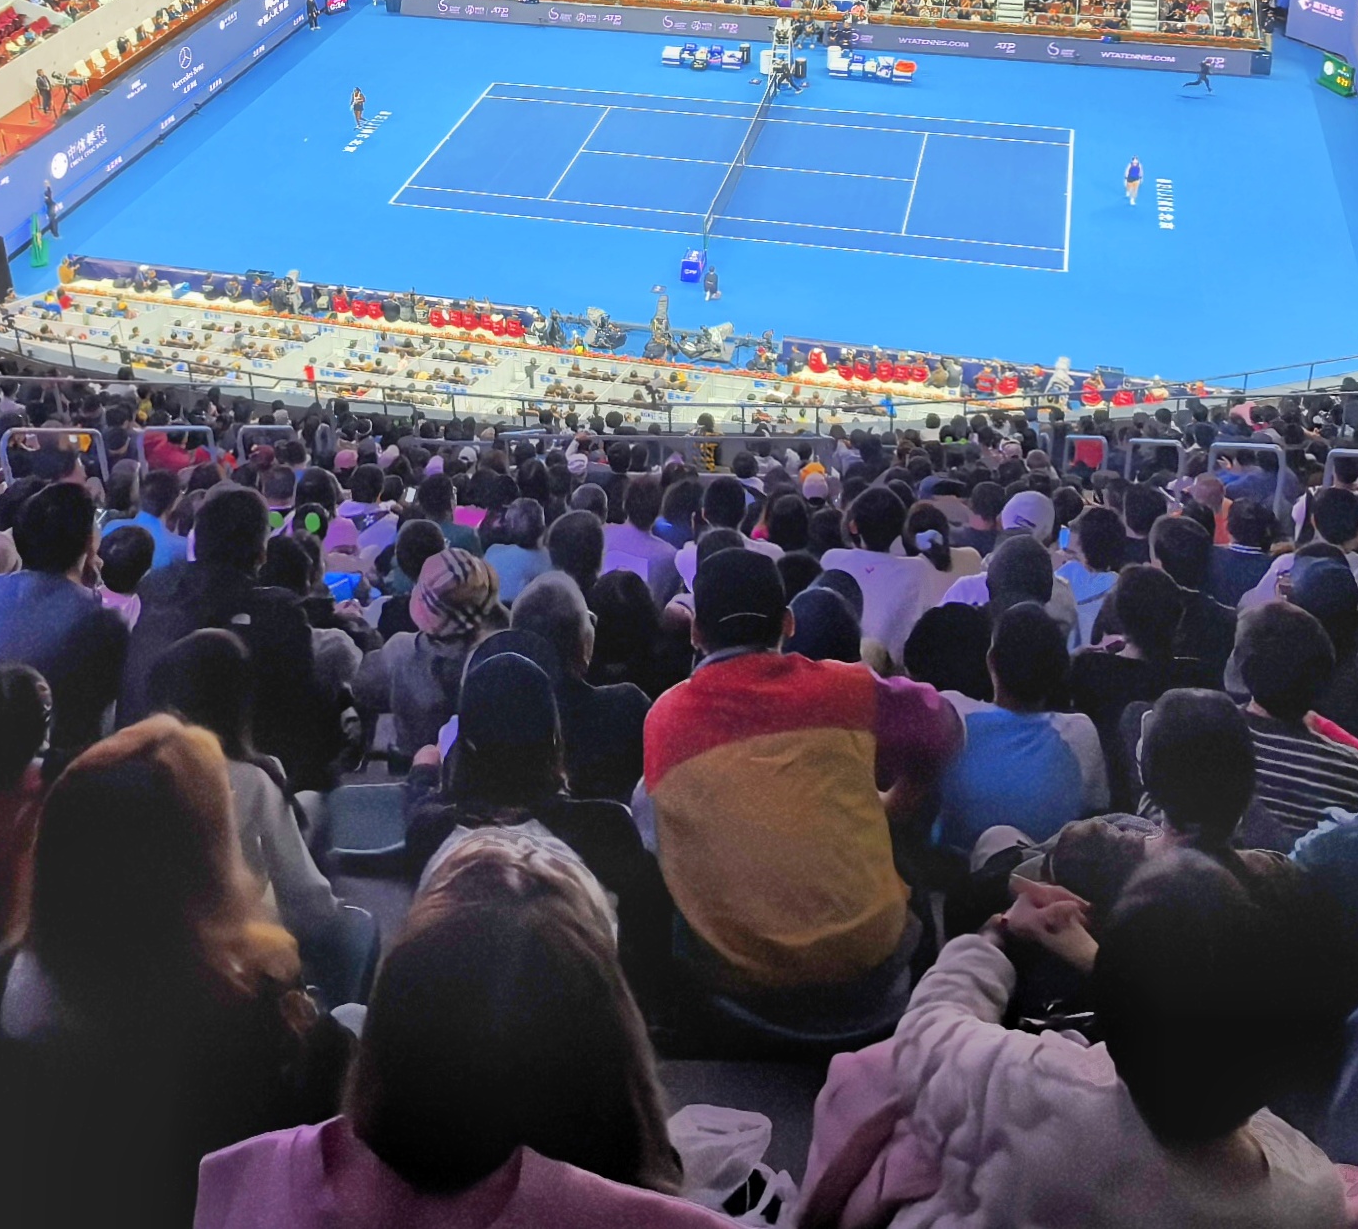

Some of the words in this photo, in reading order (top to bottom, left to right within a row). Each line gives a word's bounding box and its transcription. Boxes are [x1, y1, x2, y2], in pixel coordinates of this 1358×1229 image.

[898, 36, 969, 48] WTATENNIS.COM
[1100, 51, 1176, 63] WTATENNIS.COM
[67, 123, 107, 160] 中信银行
